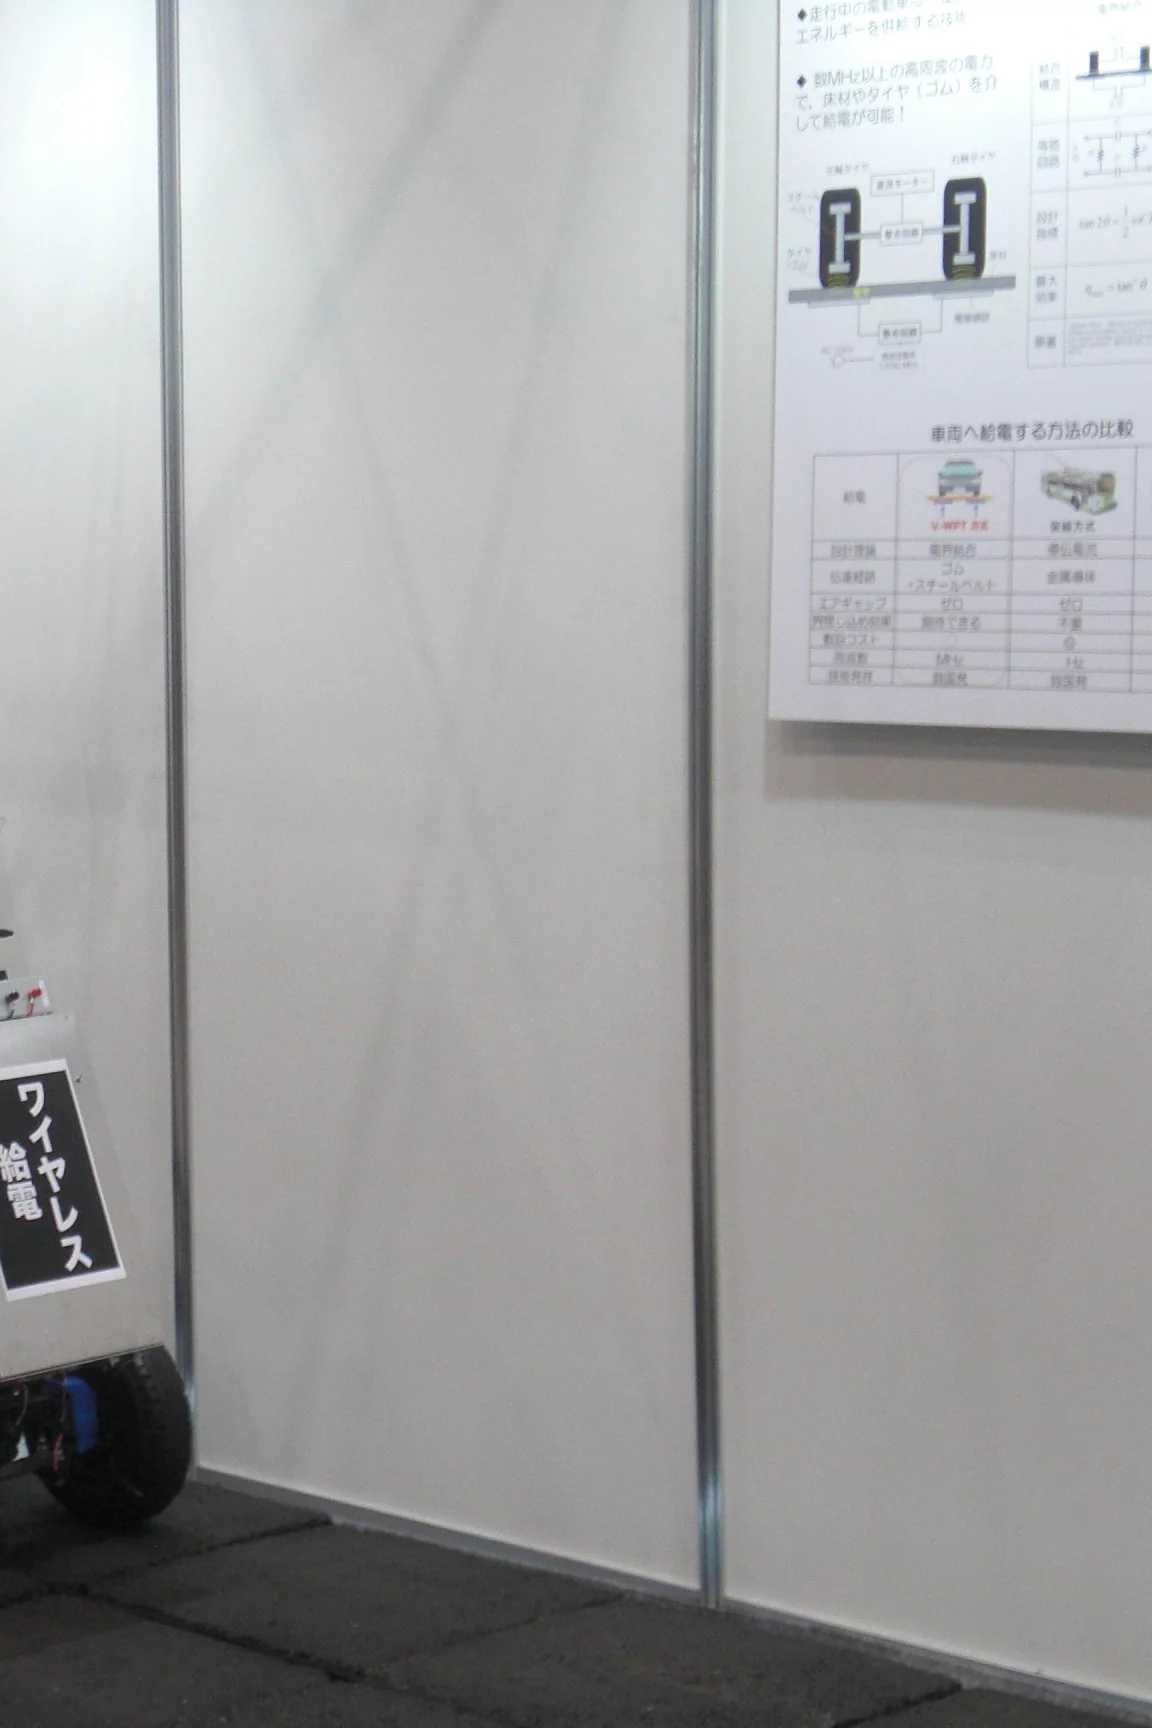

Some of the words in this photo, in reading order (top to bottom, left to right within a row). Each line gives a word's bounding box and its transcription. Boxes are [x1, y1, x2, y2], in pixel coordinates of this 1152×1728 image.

[931, 419, 1134, 443] 車両へ給電する方法の比較
[17, 1081, 94, 1272] ワイヤレス
